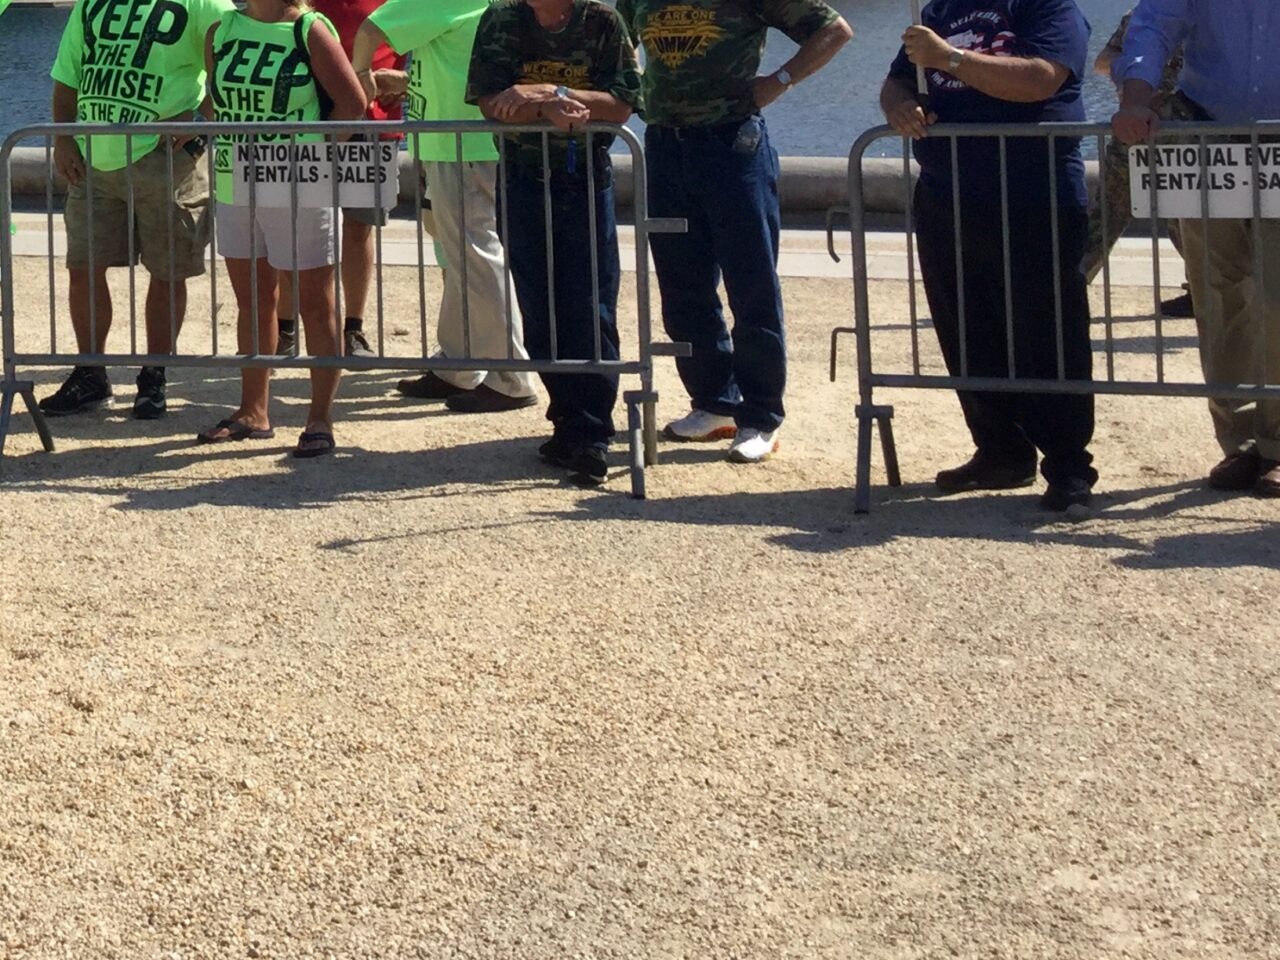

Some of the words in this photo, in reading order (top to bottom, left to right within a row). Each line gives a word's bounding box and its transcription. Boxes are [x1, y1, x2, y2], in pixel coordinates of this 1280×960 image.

[691, 9, 717, 21] ONE
[95, 43, 132, 67] THE
[81, 67, 164, 104] OMISE!
[222, 86, 266, 113] THE
[90, 102, 116, 123] THE
[326, 144, 393, 163] EVENS
[336, 165, 388, 183] SALES
